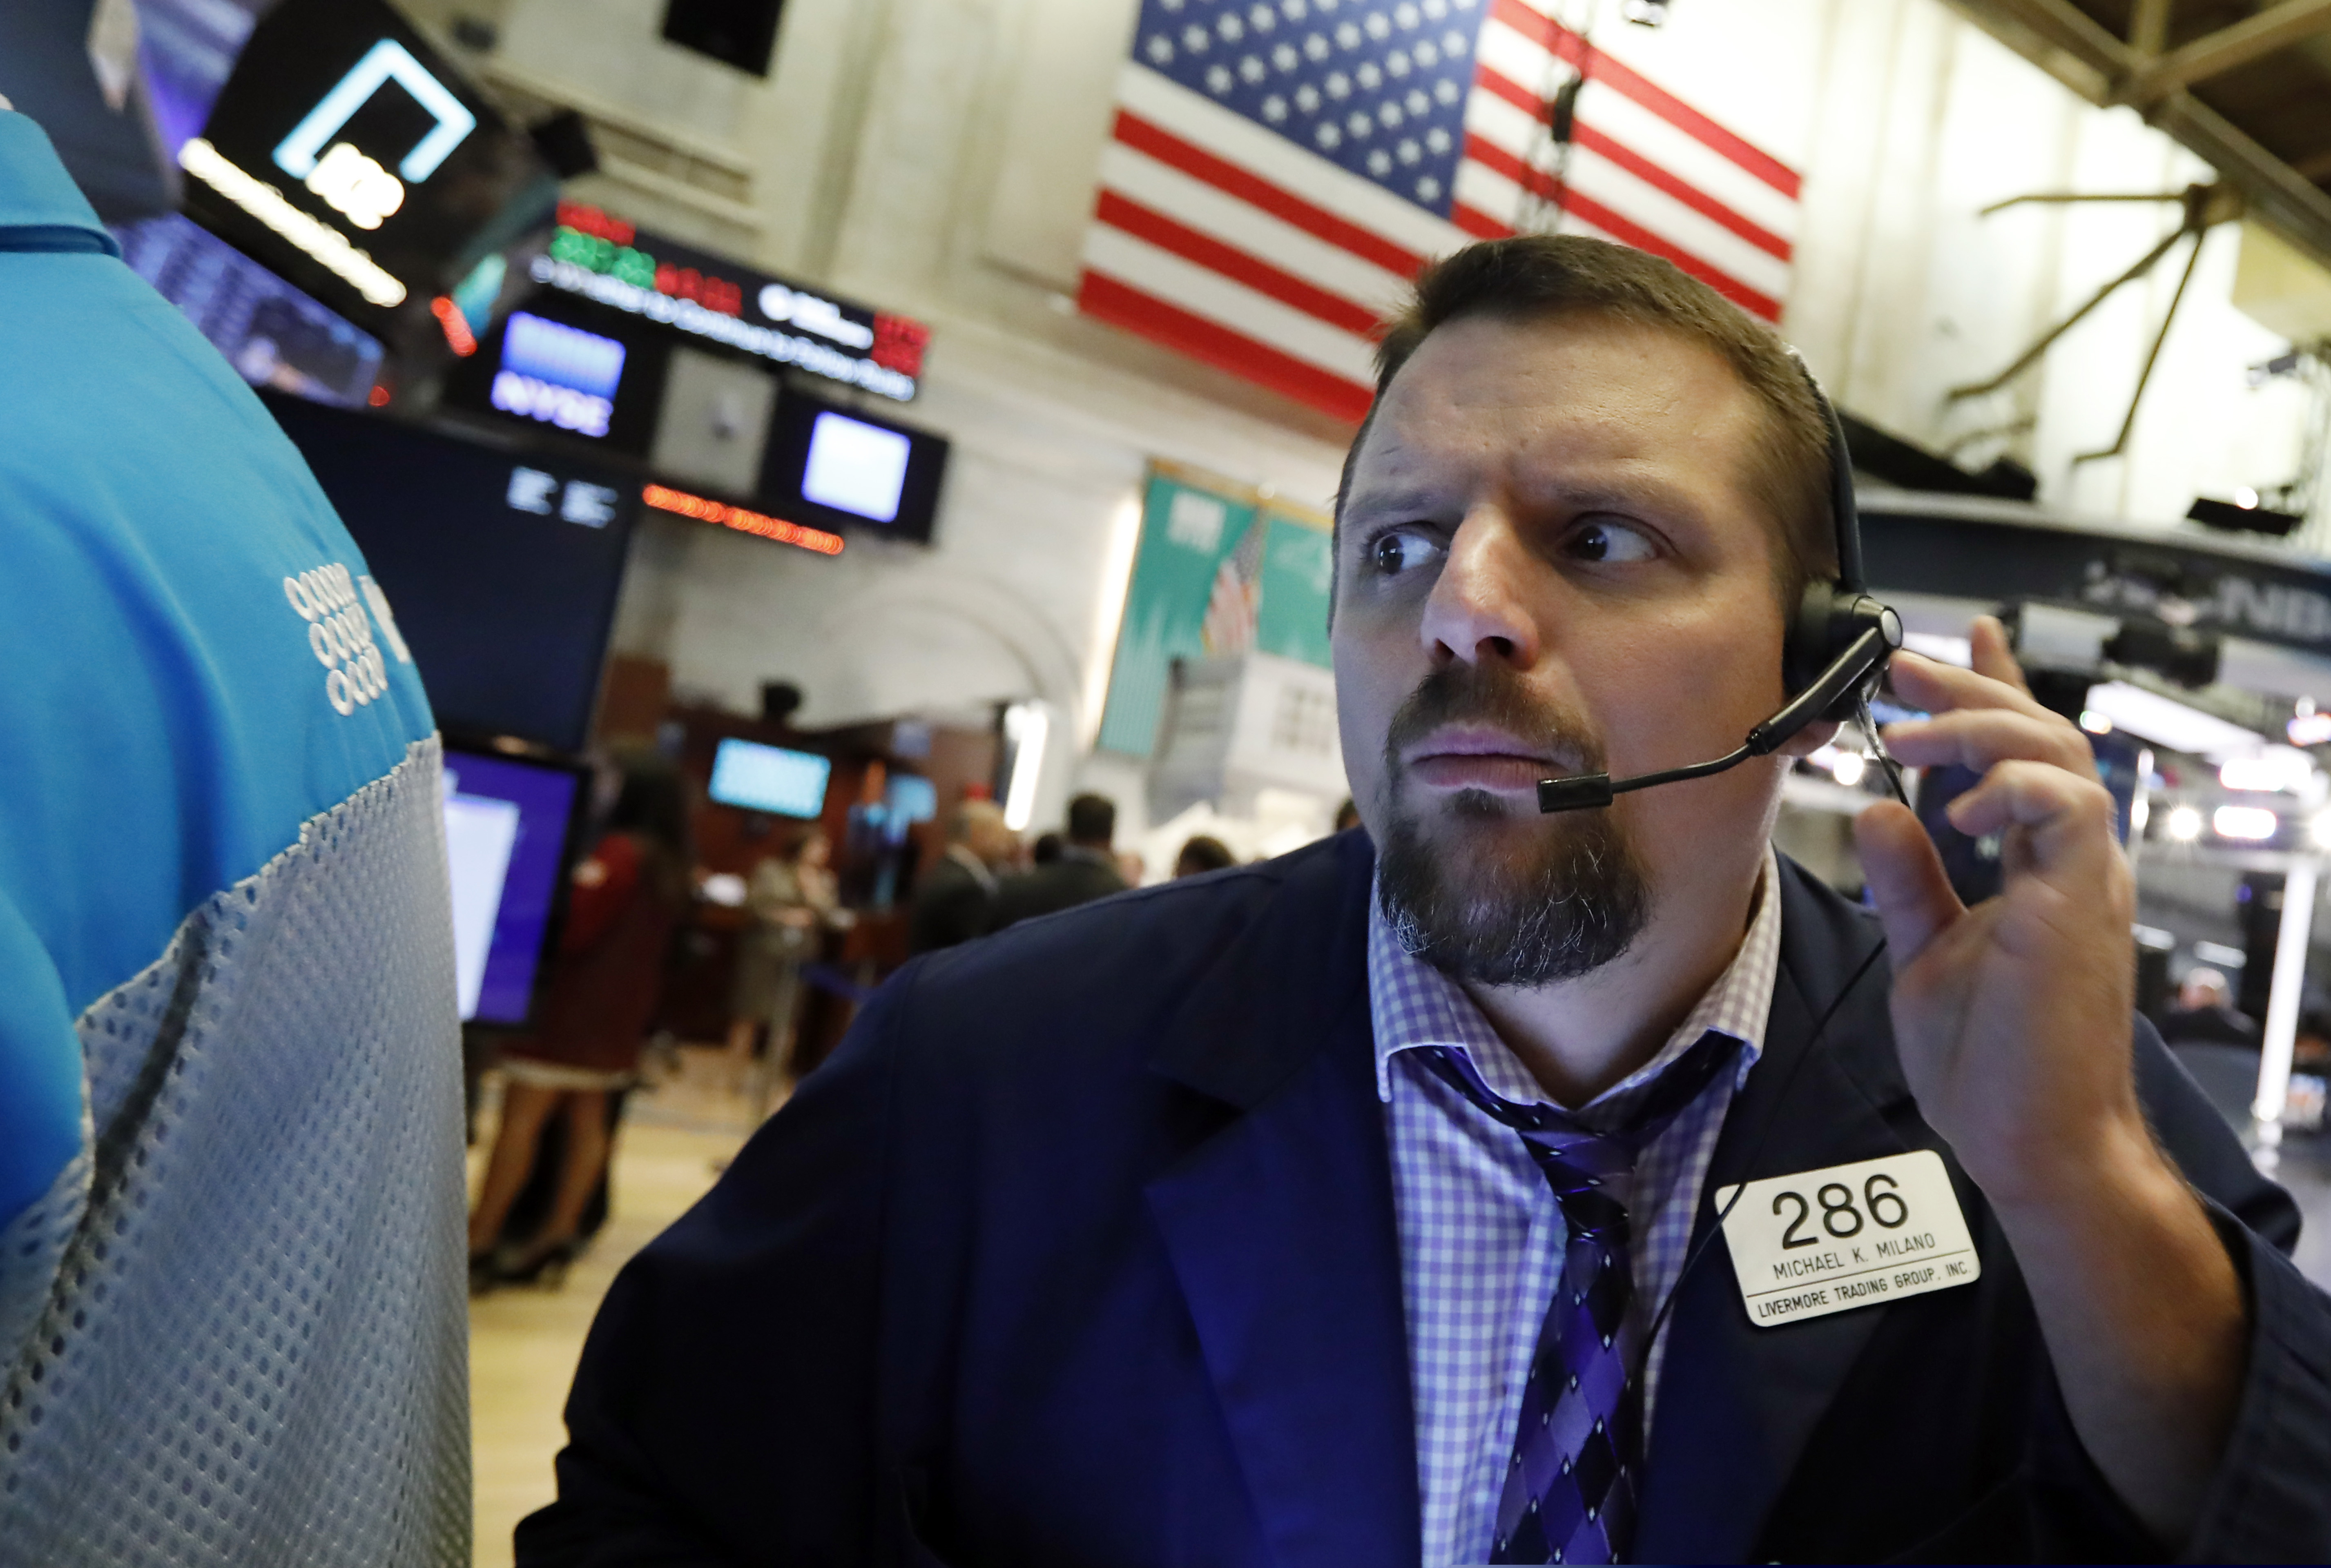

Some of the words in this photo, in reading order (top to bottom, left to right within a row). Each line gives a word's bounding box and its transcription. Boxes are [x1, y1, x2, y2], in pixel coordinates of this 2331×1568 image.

[1772, 1174, 1908, 1250] 286
[1773, 1252, 1845, 1280] MICHAEL
[1852, 1247, 1868, 1263] K.
[1876, 1233, 1935, 1257] MILANO
[1758, 1291, 1829, 1318] LIVERMORE
[1834, 1277, 1888, 1301] TRADING
[1946, 1262, 1972, 1276] INC.
